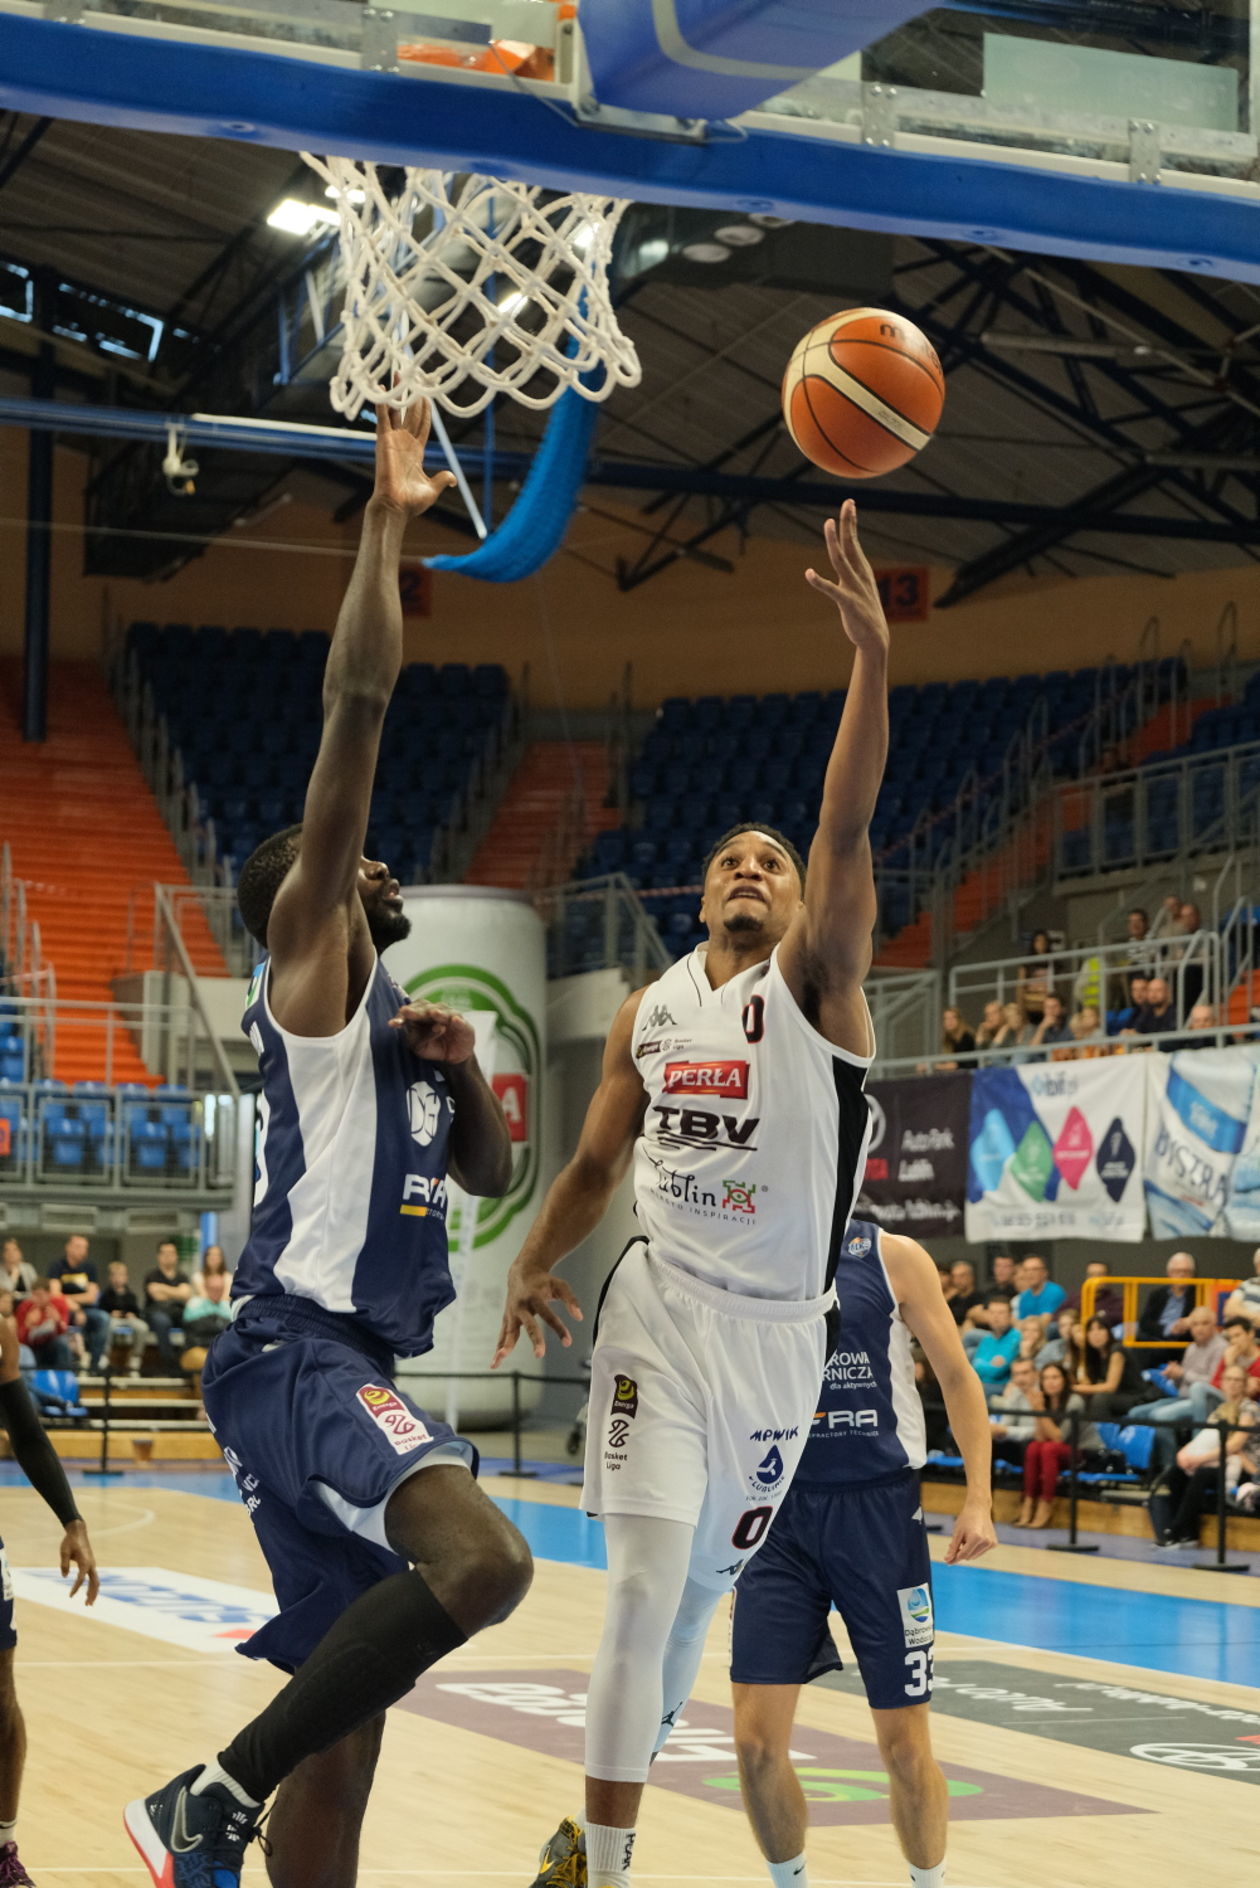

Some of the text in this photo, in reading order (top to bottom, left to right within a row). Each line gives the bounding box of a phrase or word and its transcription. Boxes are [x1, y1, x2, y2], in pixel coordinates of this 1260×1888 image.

[741, 994, 765, 1044] 0
[667, 1067, 742, 1090] PERŁA
[652, 1105, 761, 1145] TBV
[689, 1207, 756, 1225] INSPIRACJI
[731, 1505, 774, 1550] 0
